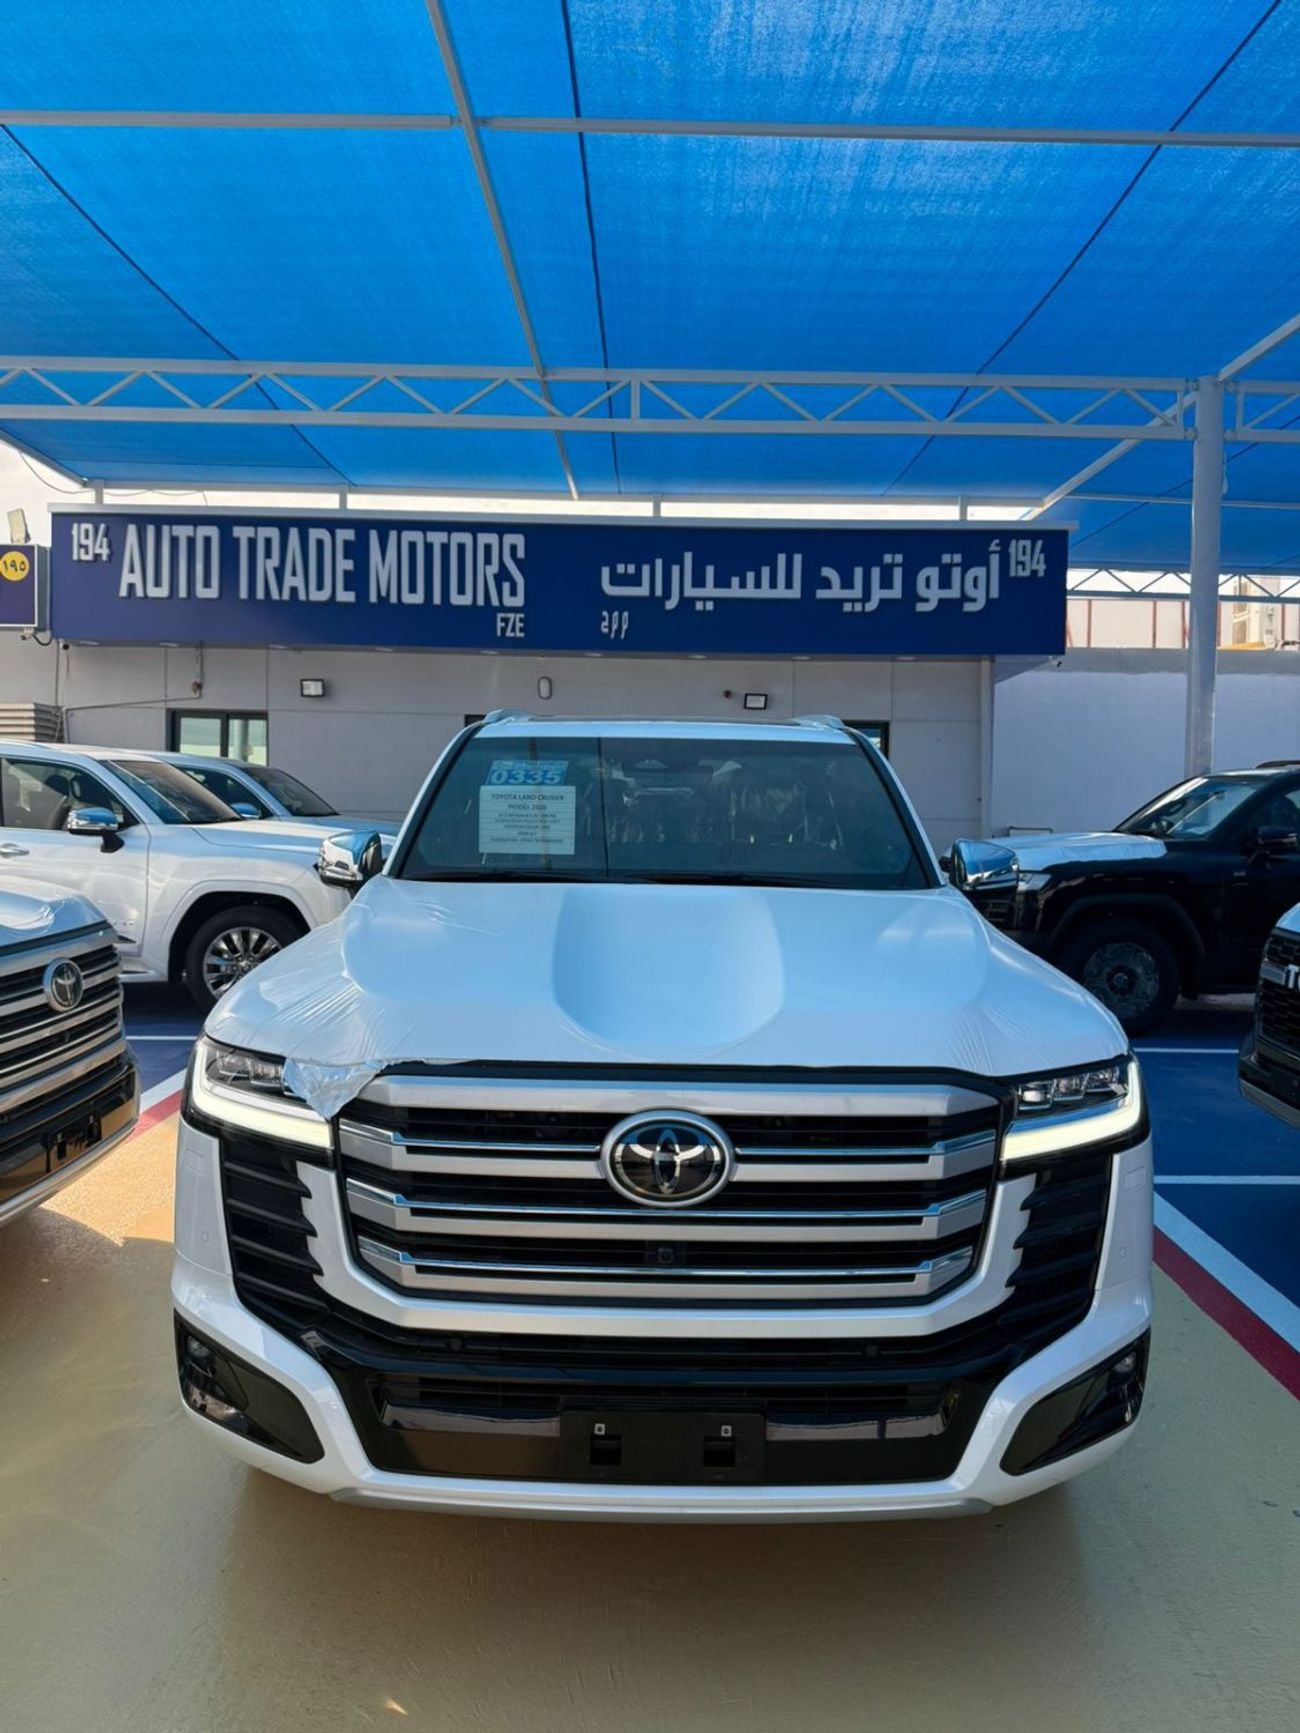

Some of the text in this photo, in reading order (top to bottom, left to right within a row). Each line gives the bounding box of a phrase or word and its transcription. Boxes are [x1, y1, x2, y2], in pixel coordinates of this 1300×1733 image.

[72, 523, 110, 561] 194
[1008, 539, 1047, 577] 194
[118, 524, 526, 607] AUTO TRADE MOTORS
[601, 539, 1000, 612] أوتو تريد للسيارات
[496, 612, 526, 637] FZE
[491, 769, 562, 785] 0335
